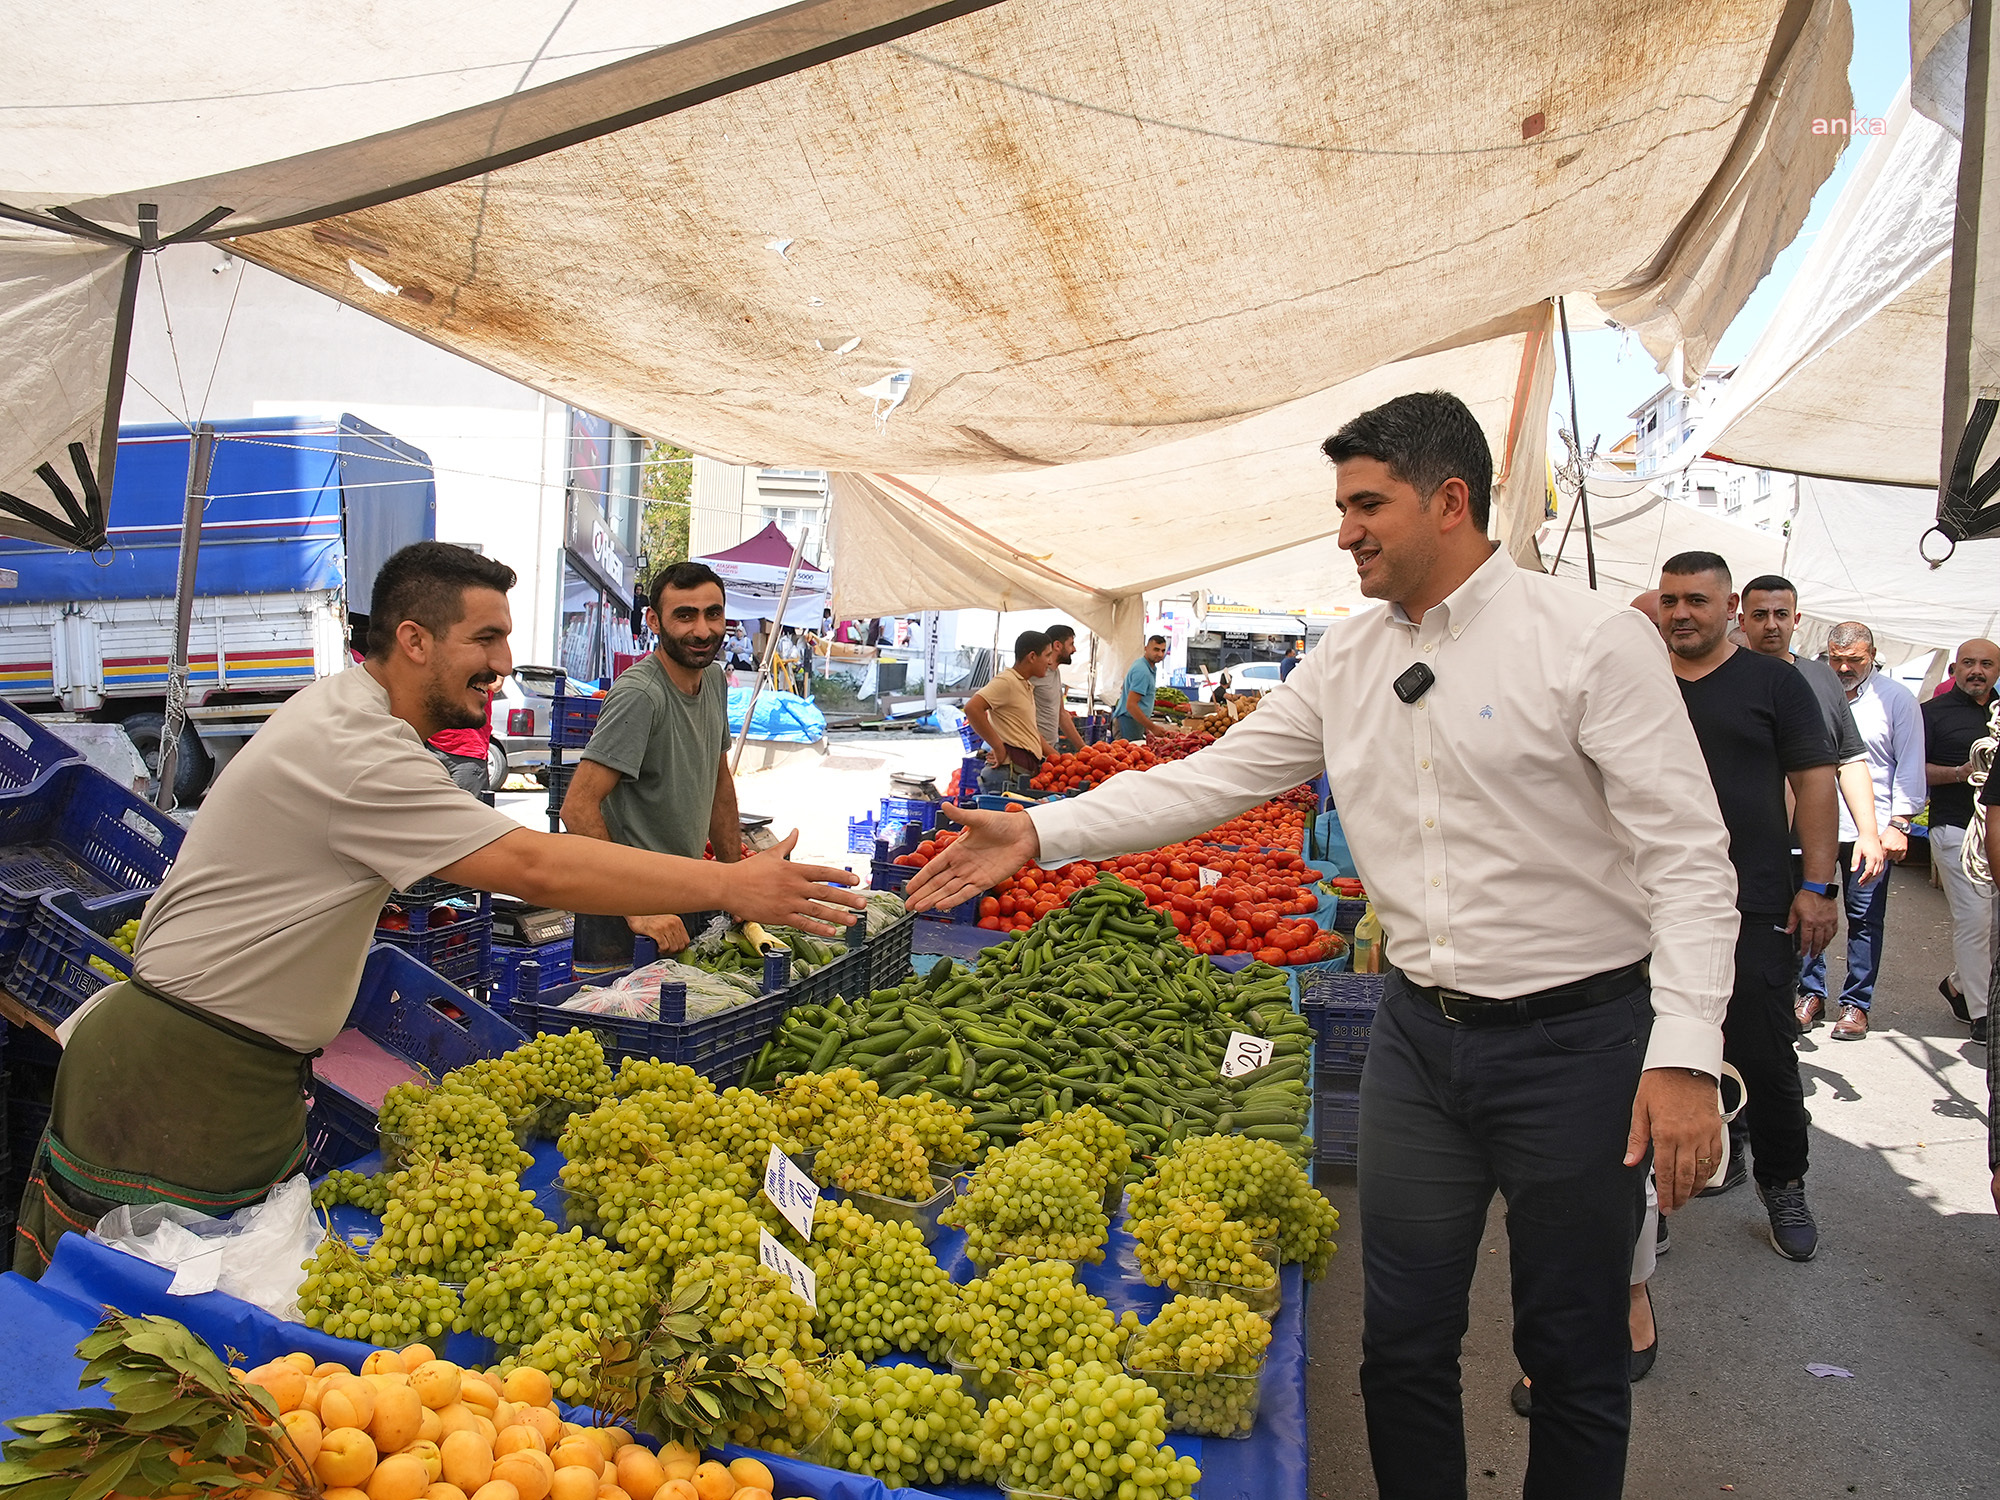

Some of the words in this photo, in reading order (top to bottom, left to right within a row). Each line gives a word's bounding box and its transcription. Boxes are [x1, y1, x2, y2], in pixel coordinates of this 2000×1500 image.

[69, 965, 103, 996] TEM
[1237, 1042, 1262, 1068] 20
[796, 1182, 812, 1209] 60
